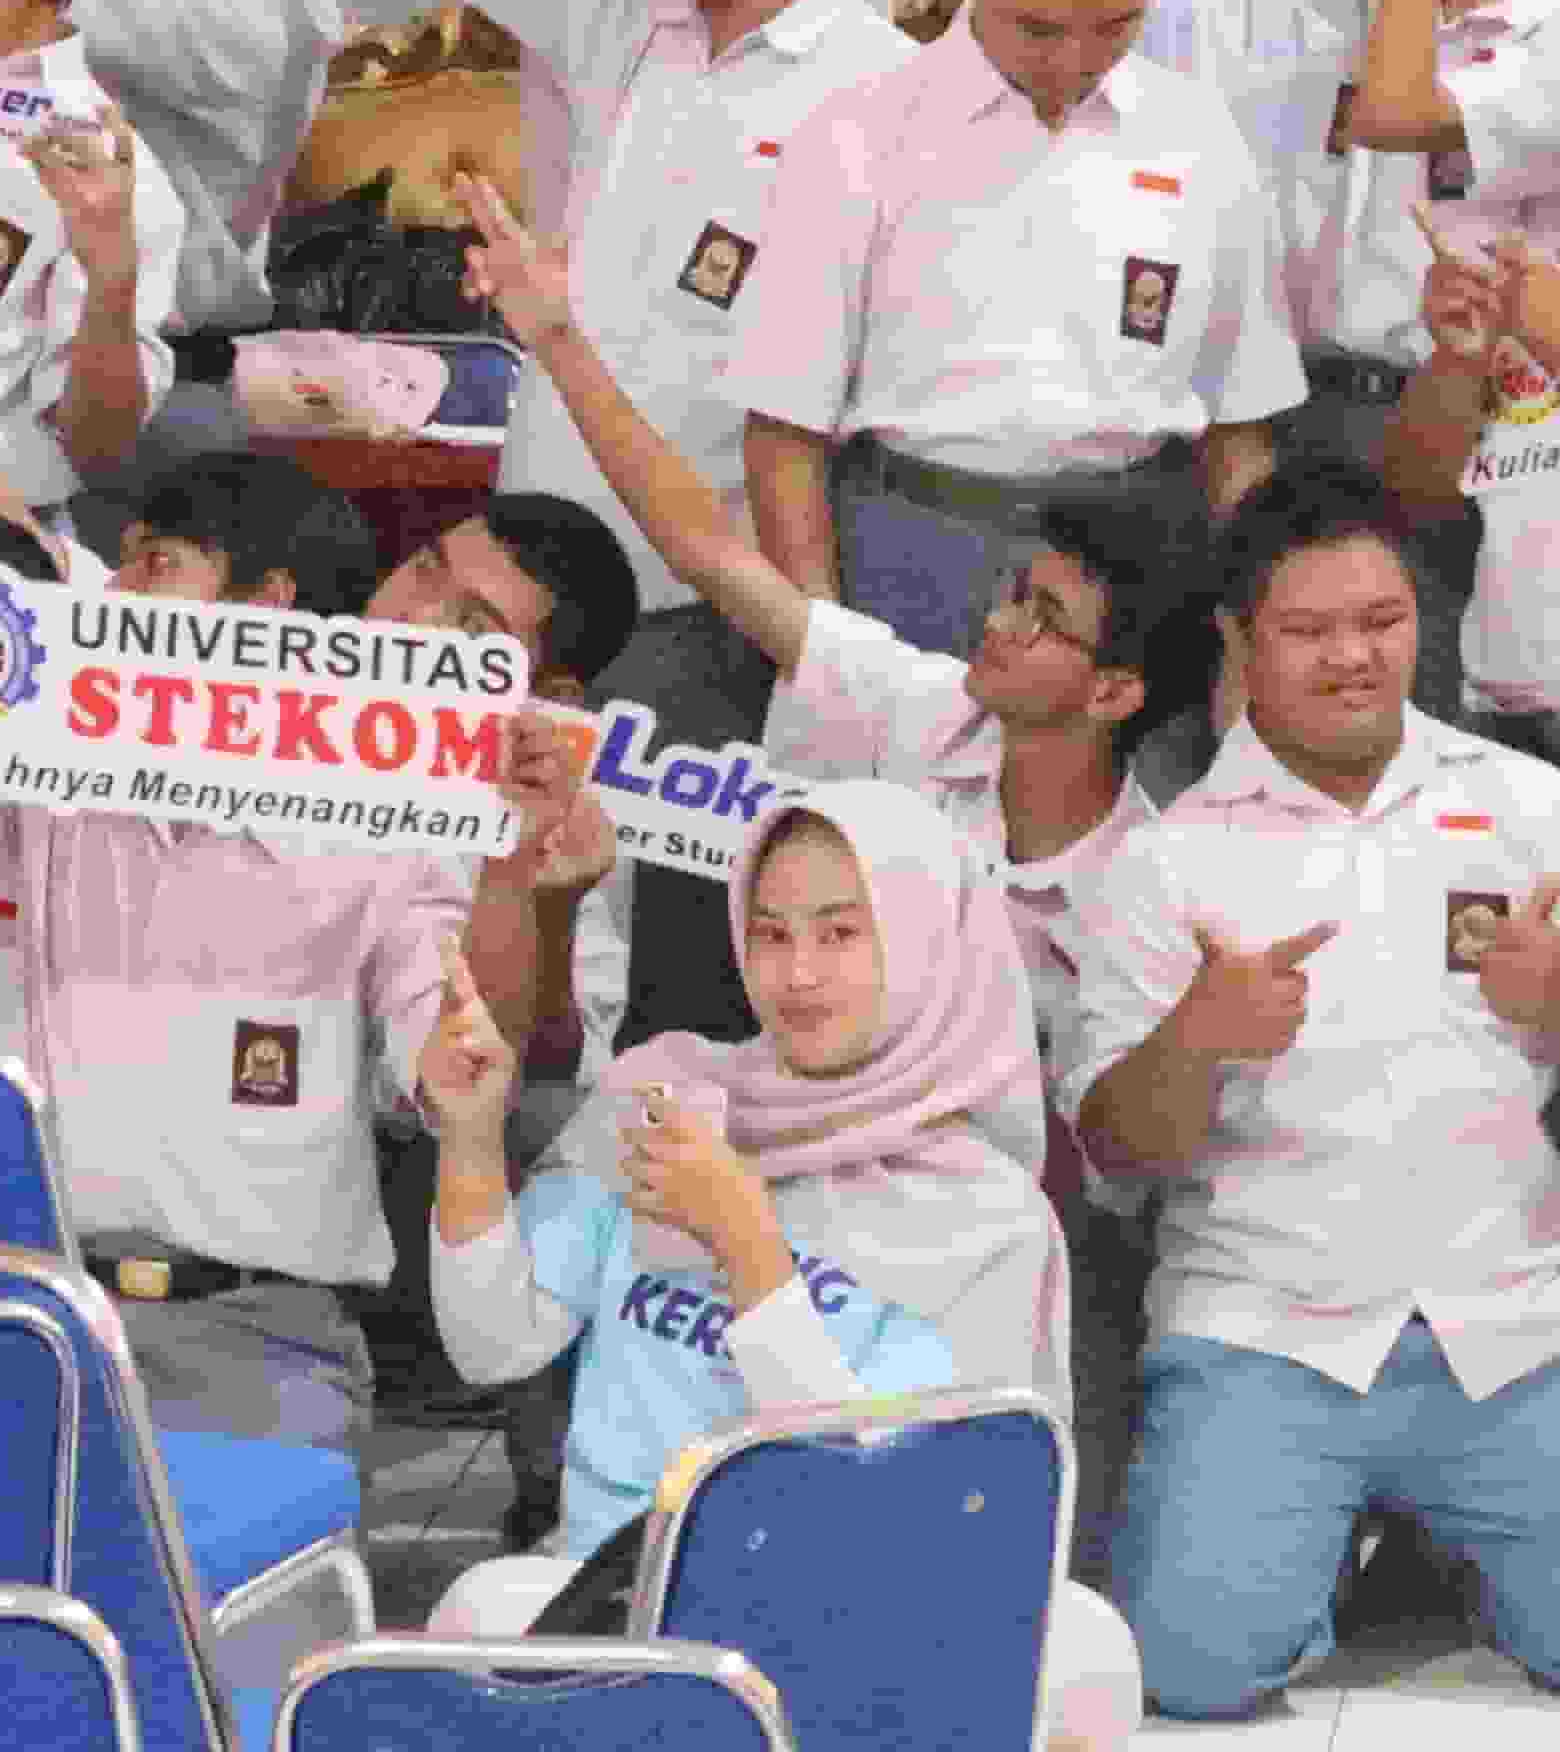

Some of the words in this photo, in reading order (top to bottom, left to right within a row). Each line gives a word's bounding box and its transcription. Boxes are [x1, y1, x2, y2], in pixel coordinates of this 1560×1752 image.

[70, 600, 513, 696] UNIVERSITAS
[66, 666, 505, 785] STEKOM
[126, 767, 482, 840] Menyenangkan
[494, 809, 512, 846] !
